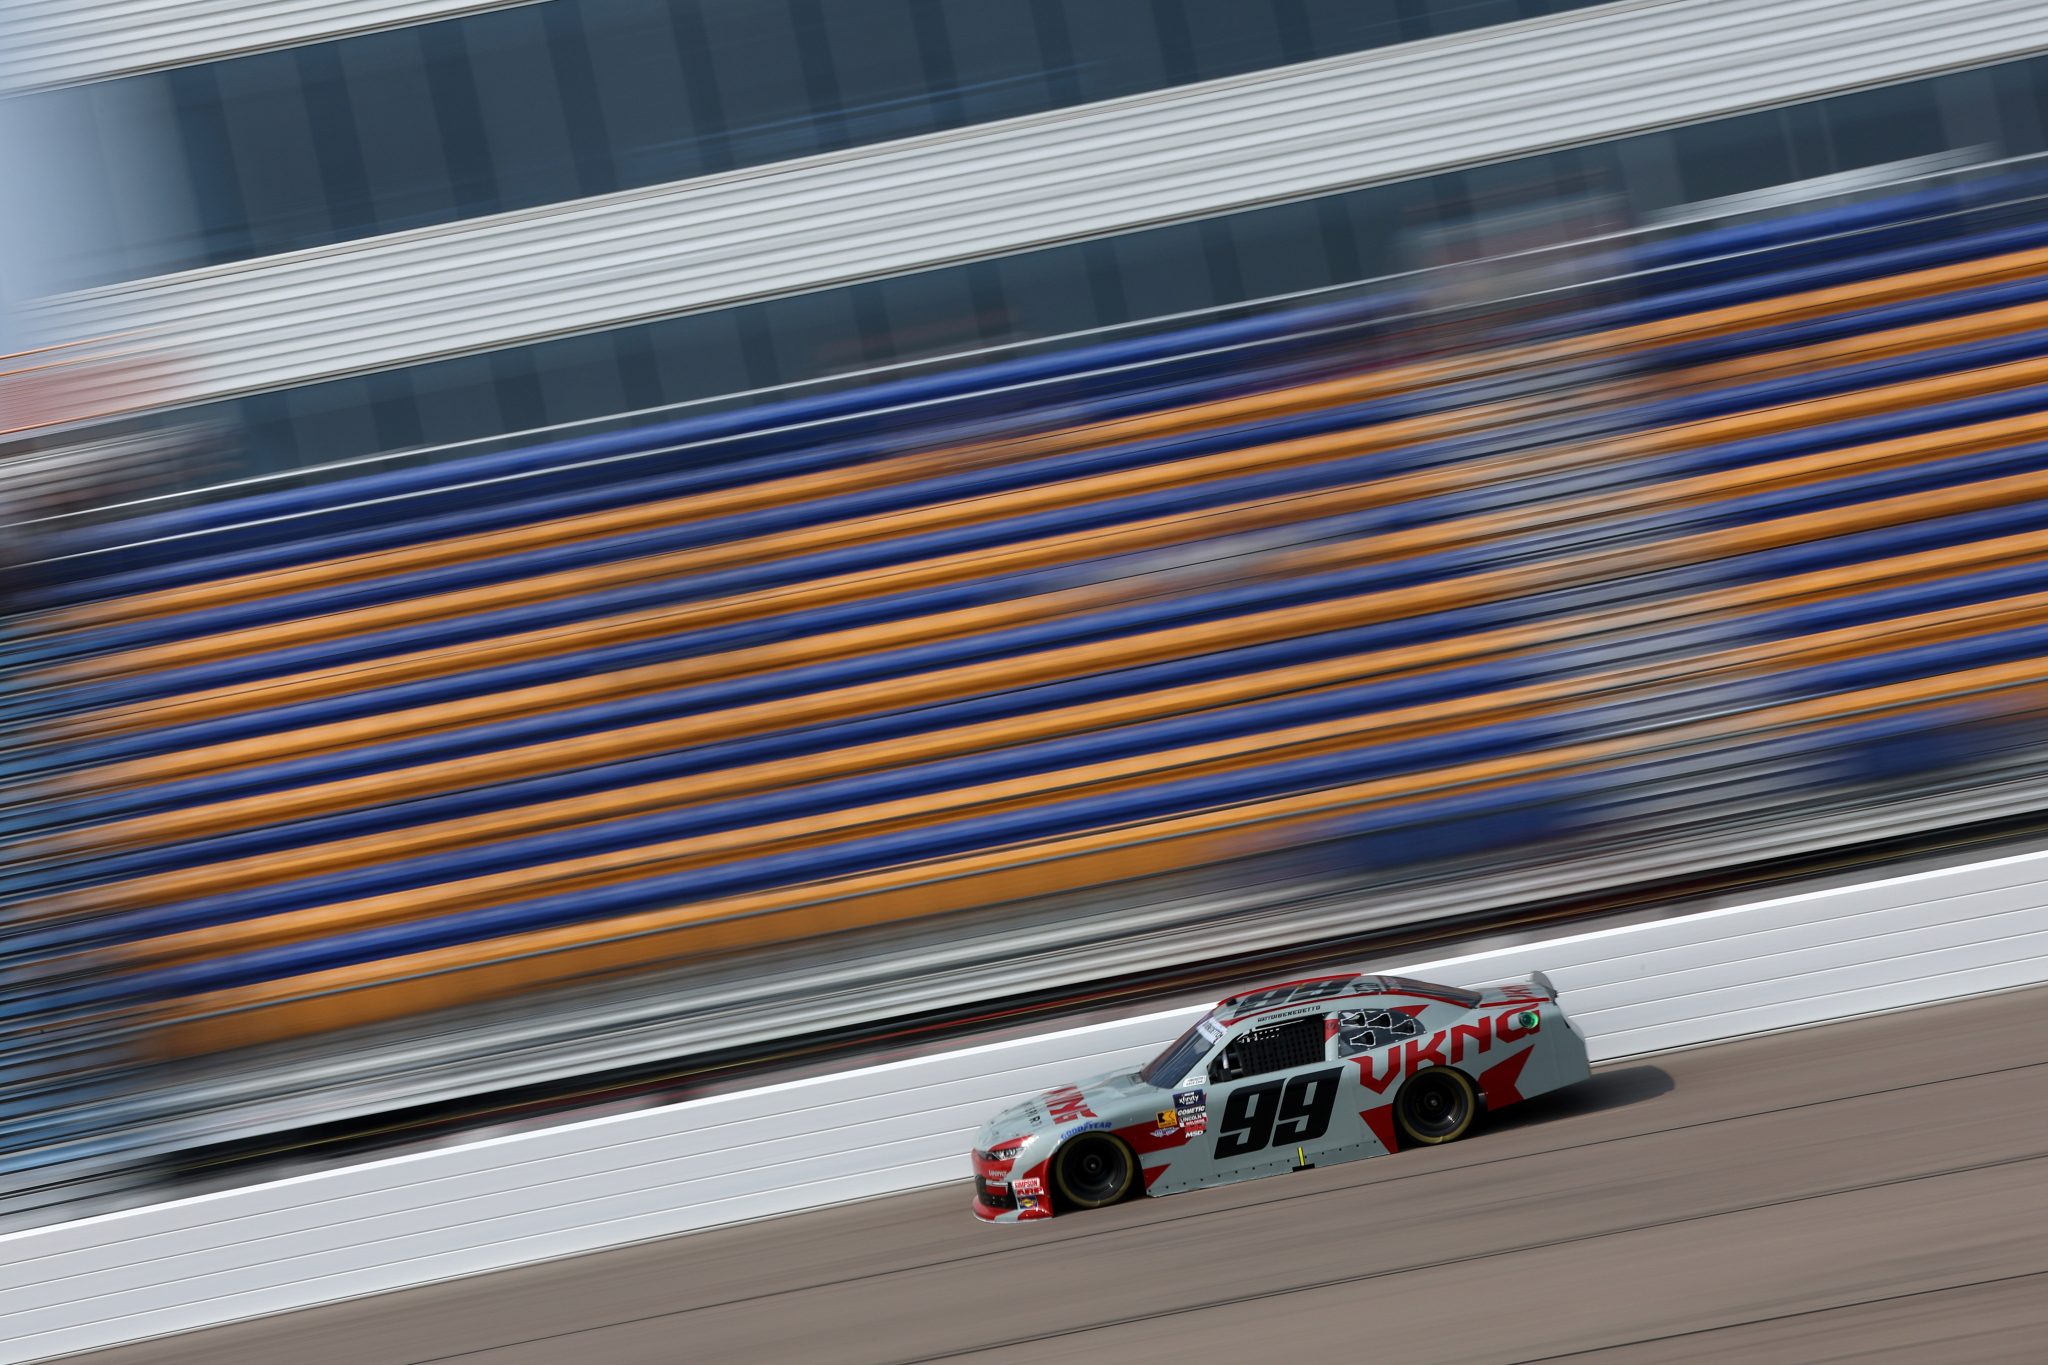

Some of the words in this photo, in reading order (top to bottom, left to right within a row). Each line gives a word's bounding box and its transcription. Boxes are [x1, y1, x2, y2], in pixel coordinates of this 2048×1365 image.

[1177, 1105, 1205, 1116] COMETIC
[1213, 1065, 1346, 1160] 99
[1060, 1120, 1112, 1141] GOODYEAR
[1185, 1130, 1203, 1138] MSD
[1014, 1180, 1037, 1188] SIMPSON
